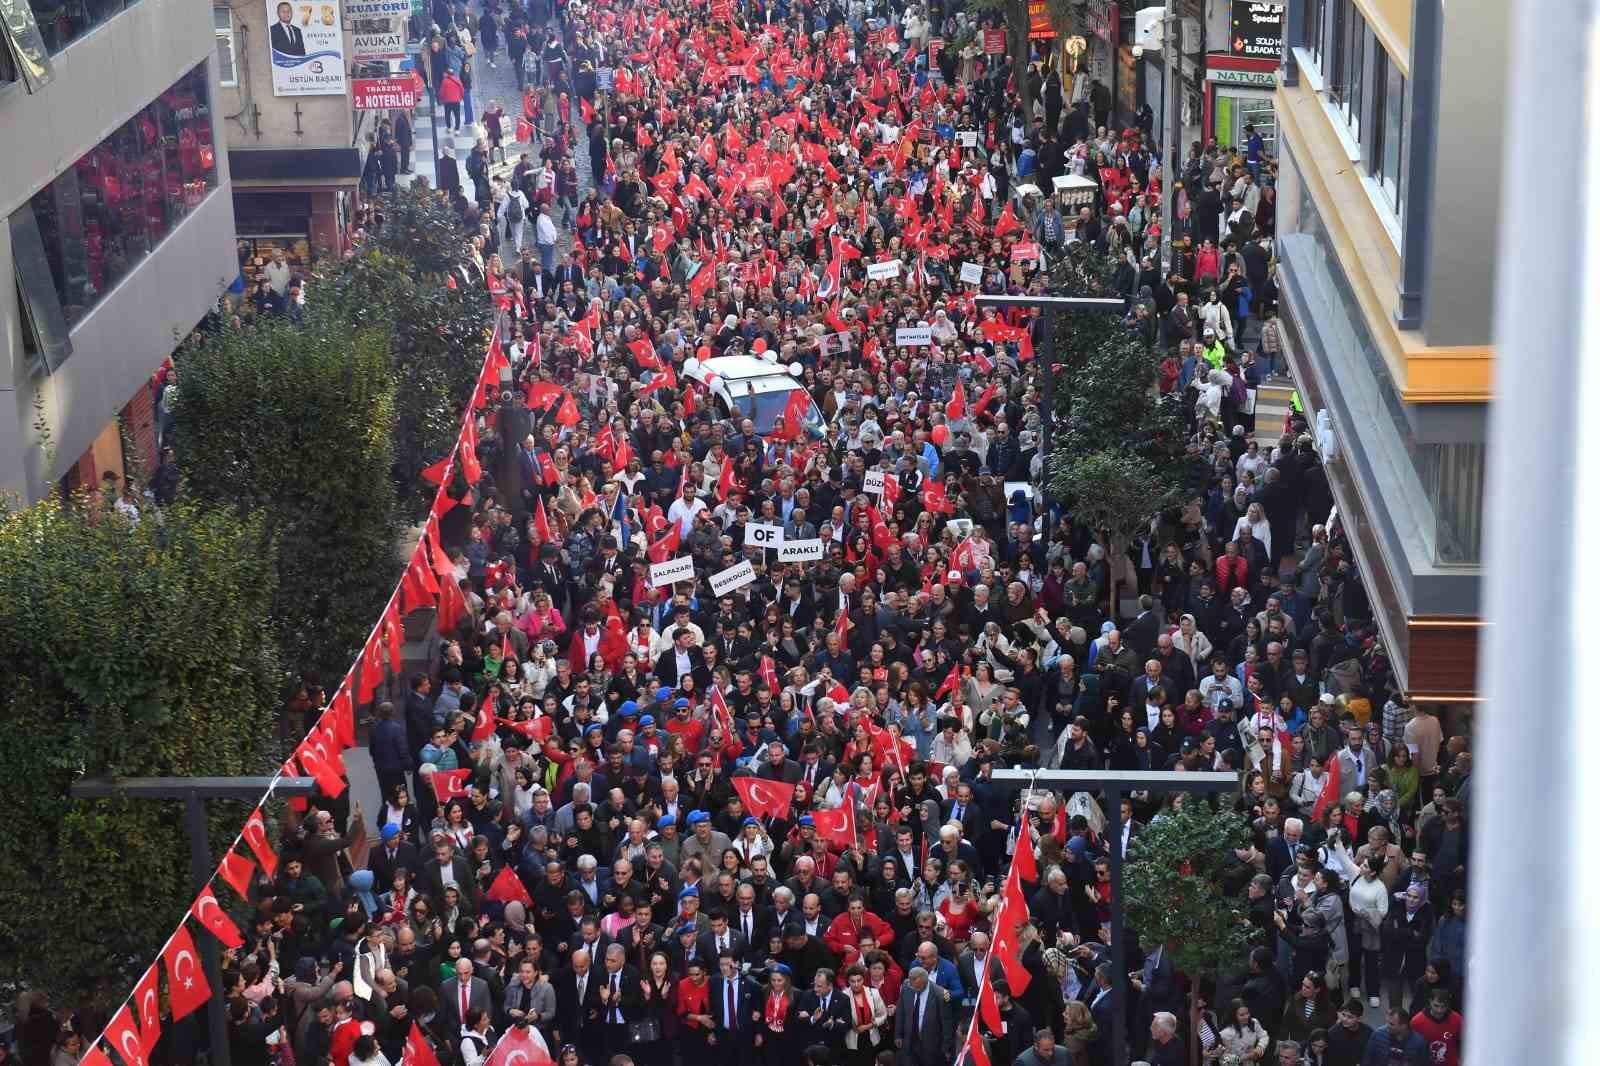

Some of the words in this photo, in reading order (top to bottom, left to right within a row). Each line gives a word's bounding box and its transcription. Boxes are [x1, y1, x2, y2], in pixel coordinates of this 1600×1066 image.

[1252, 13, 1280, 24] Special
[354, 35, 401, 48] AVUKAT
[1255, 37, 1274, 46] SOLD
[1246, 45, 1275, 55] BURADA
[355, 95, 364, 108] 2.
[365, 91, 414, 108] NOTERLİĞİ
[866, 478, 883, 488] DÜZ
[754, 529, 775, 542] OF
[782, 546, 819, 556] ARAKLI
[653, 564, 692, 578] SALPAZARI
